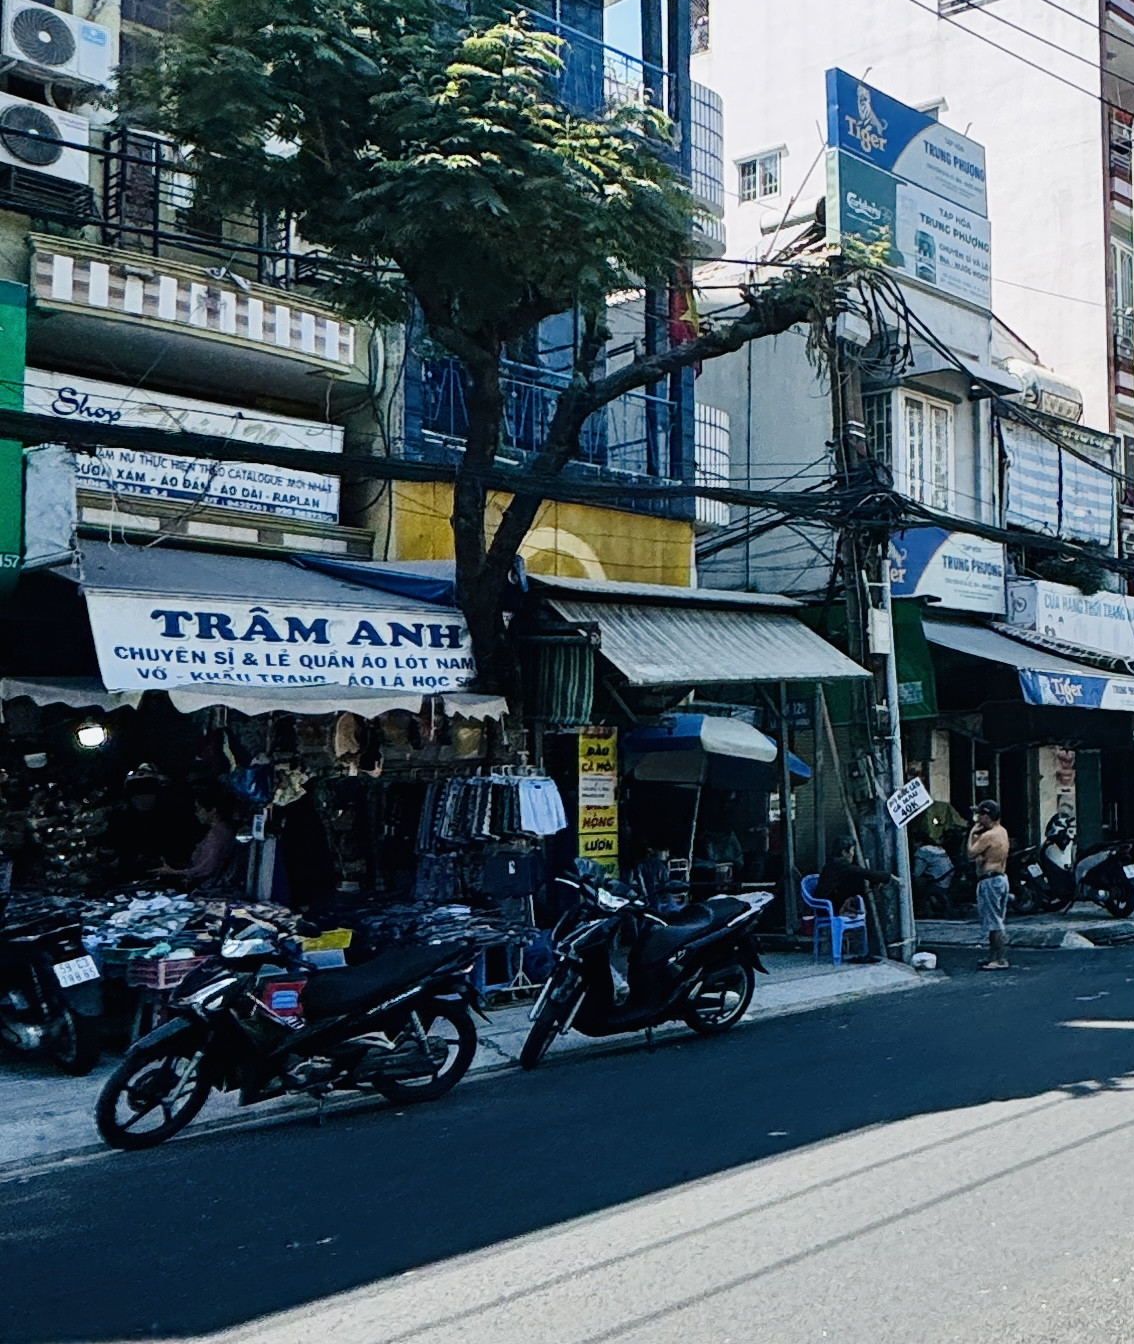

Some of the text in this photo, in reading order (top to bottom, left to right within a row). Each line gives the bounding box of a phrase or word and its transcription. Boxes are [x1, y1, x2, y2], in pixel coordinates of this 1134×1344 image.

[845, 114, 888, 153] Tiger
[923, 139, 952, 166] TRUNG
[919, 211, 951, 236] TRUNG
[51, 386, 122, 424] Shop
[160, 471, 179, 488] ÁO
[227, 467, 284, 488] CATALOGUE
[941, 554, 970, 573] TRUNG
[150, 607, 464, 650] TRÂM ANH
[113, 646, 474, 671] CHUYÊN SỈ & LẺ QUẦN ÁO LÓT NAM
[136, 665, 169, 681] VỚ
[189, 666, 251, 683] KHẨU
[255, 672, 327, 684] TRANG
[347, 672, 375, 687] ÁO
[412, 675, 450, 689] HỌC
[1050, 676, 1083, 705] Tiger
[901, 800, 919, 816] 40K
